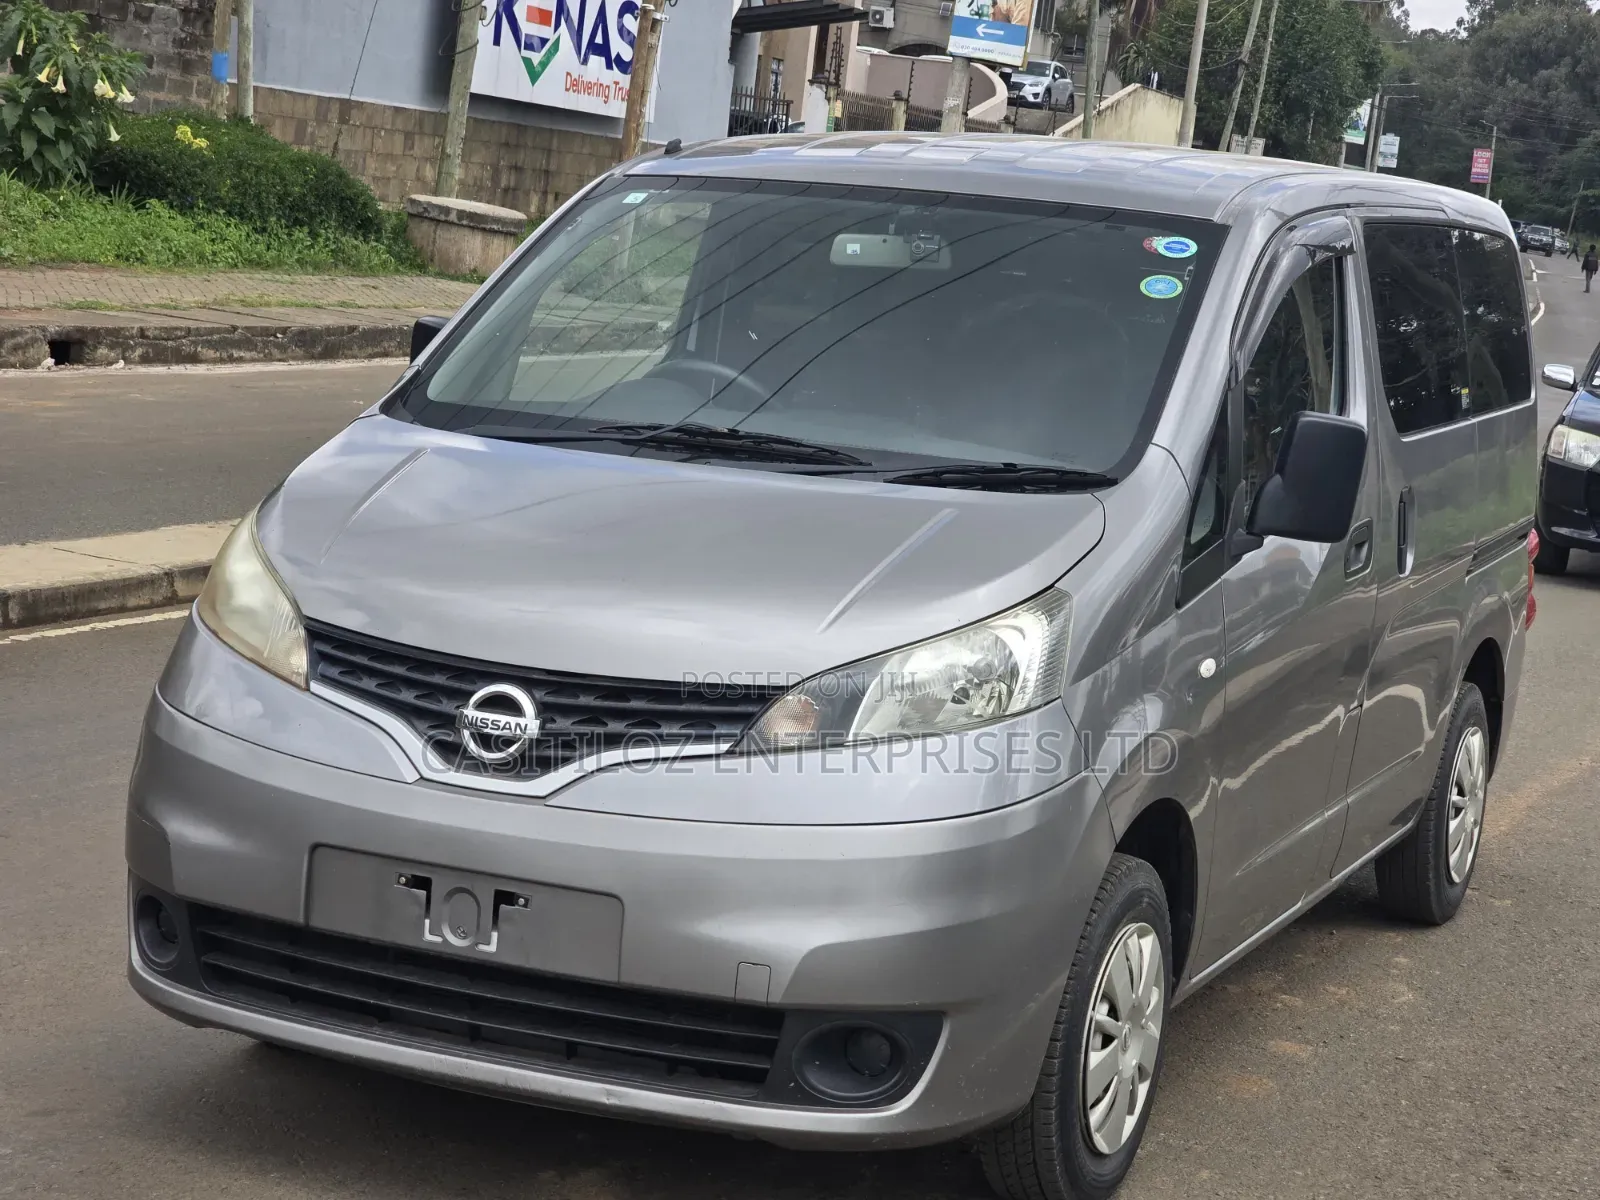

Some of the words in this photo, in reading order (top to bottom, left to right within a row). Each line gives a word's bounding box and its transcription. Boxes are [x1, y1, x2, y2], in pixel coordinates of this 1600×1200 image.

[493, 0, 641, 76] KENAS
[565, 72, 610, 104] Delivering
[462, 714, 529, 735] NISSAN
